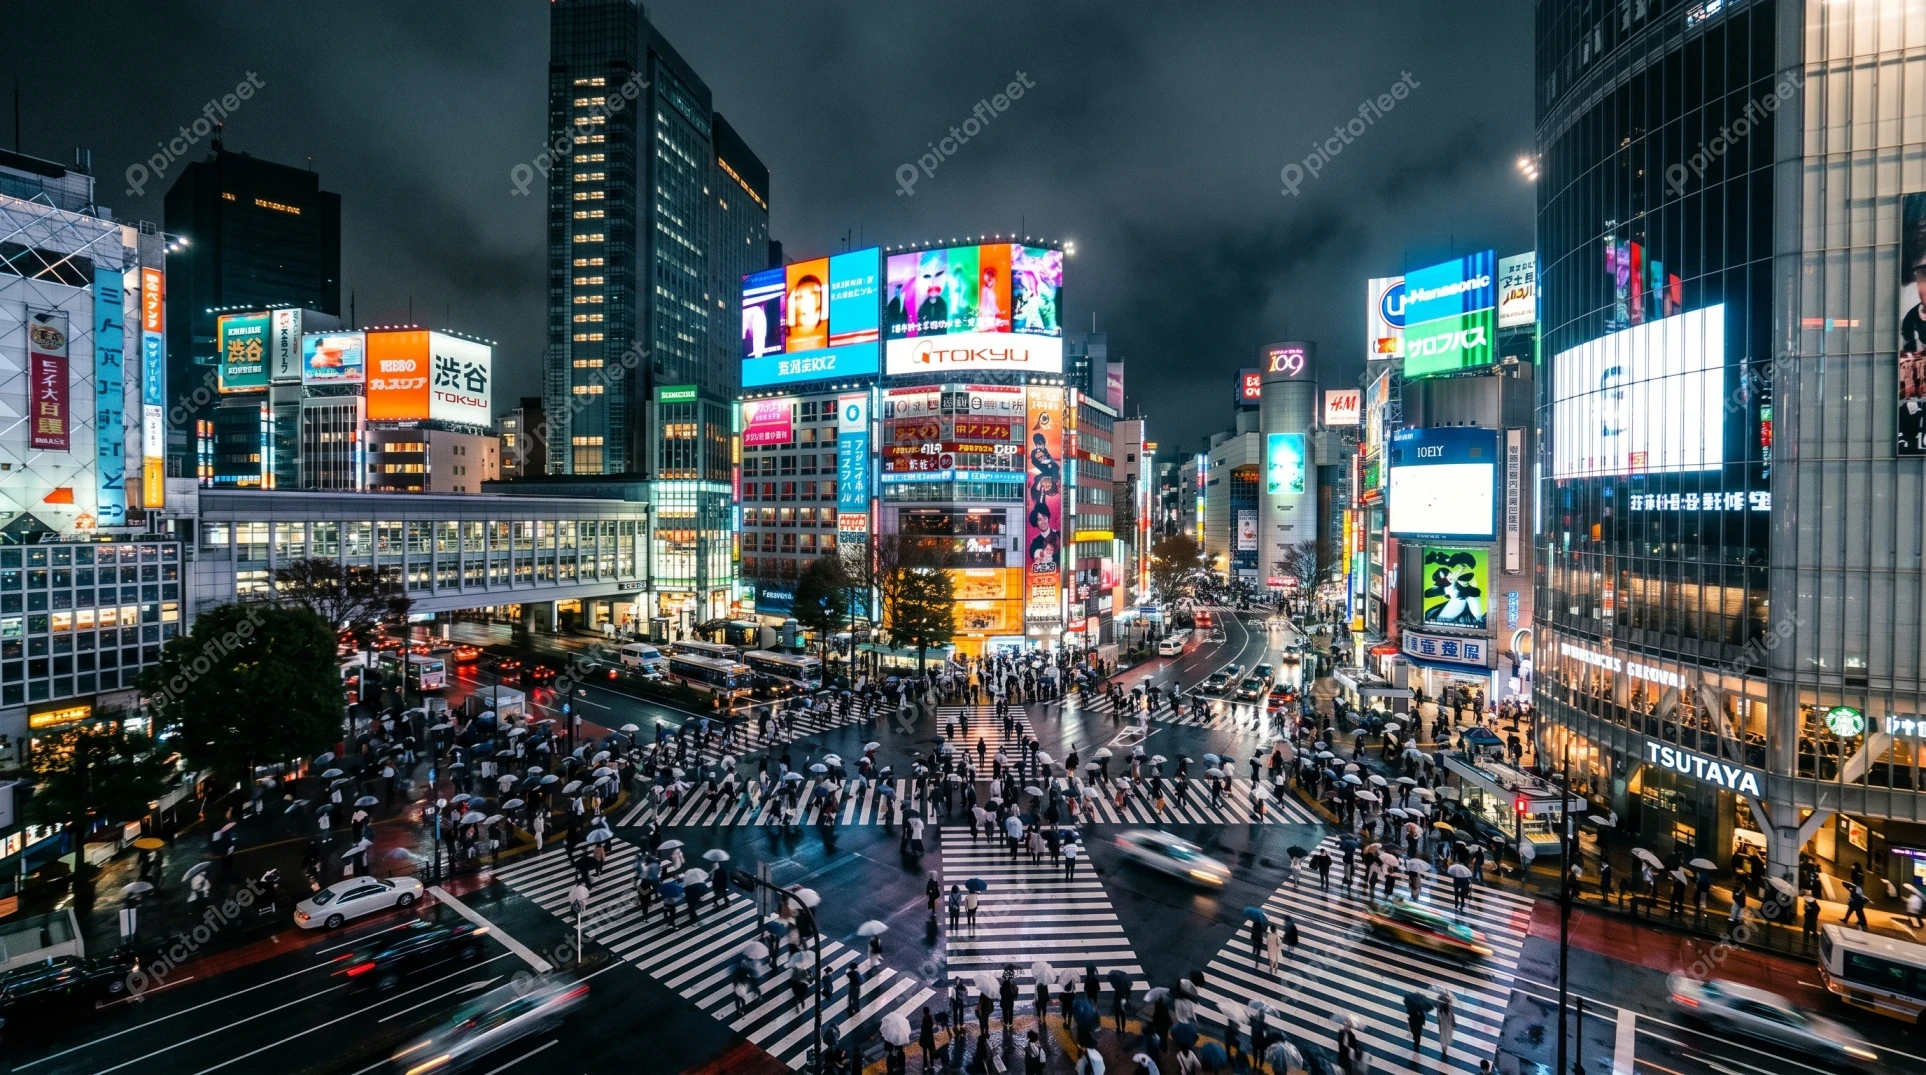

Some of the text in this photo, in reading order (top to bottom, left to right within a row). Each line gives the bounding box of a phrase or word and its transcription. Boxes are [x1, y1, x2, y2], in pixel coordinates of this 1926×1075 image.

[227, 337, 264, 363] 渋谷
[932, 348, 1029, 363] TOKYU
[434, 354, 487, 394] 渋谷
[1268, 353, 1304, 377] 109
[434, 390, 488, 408] TOKYU
[1647, 741, 1760, 797] TSUTAYA
